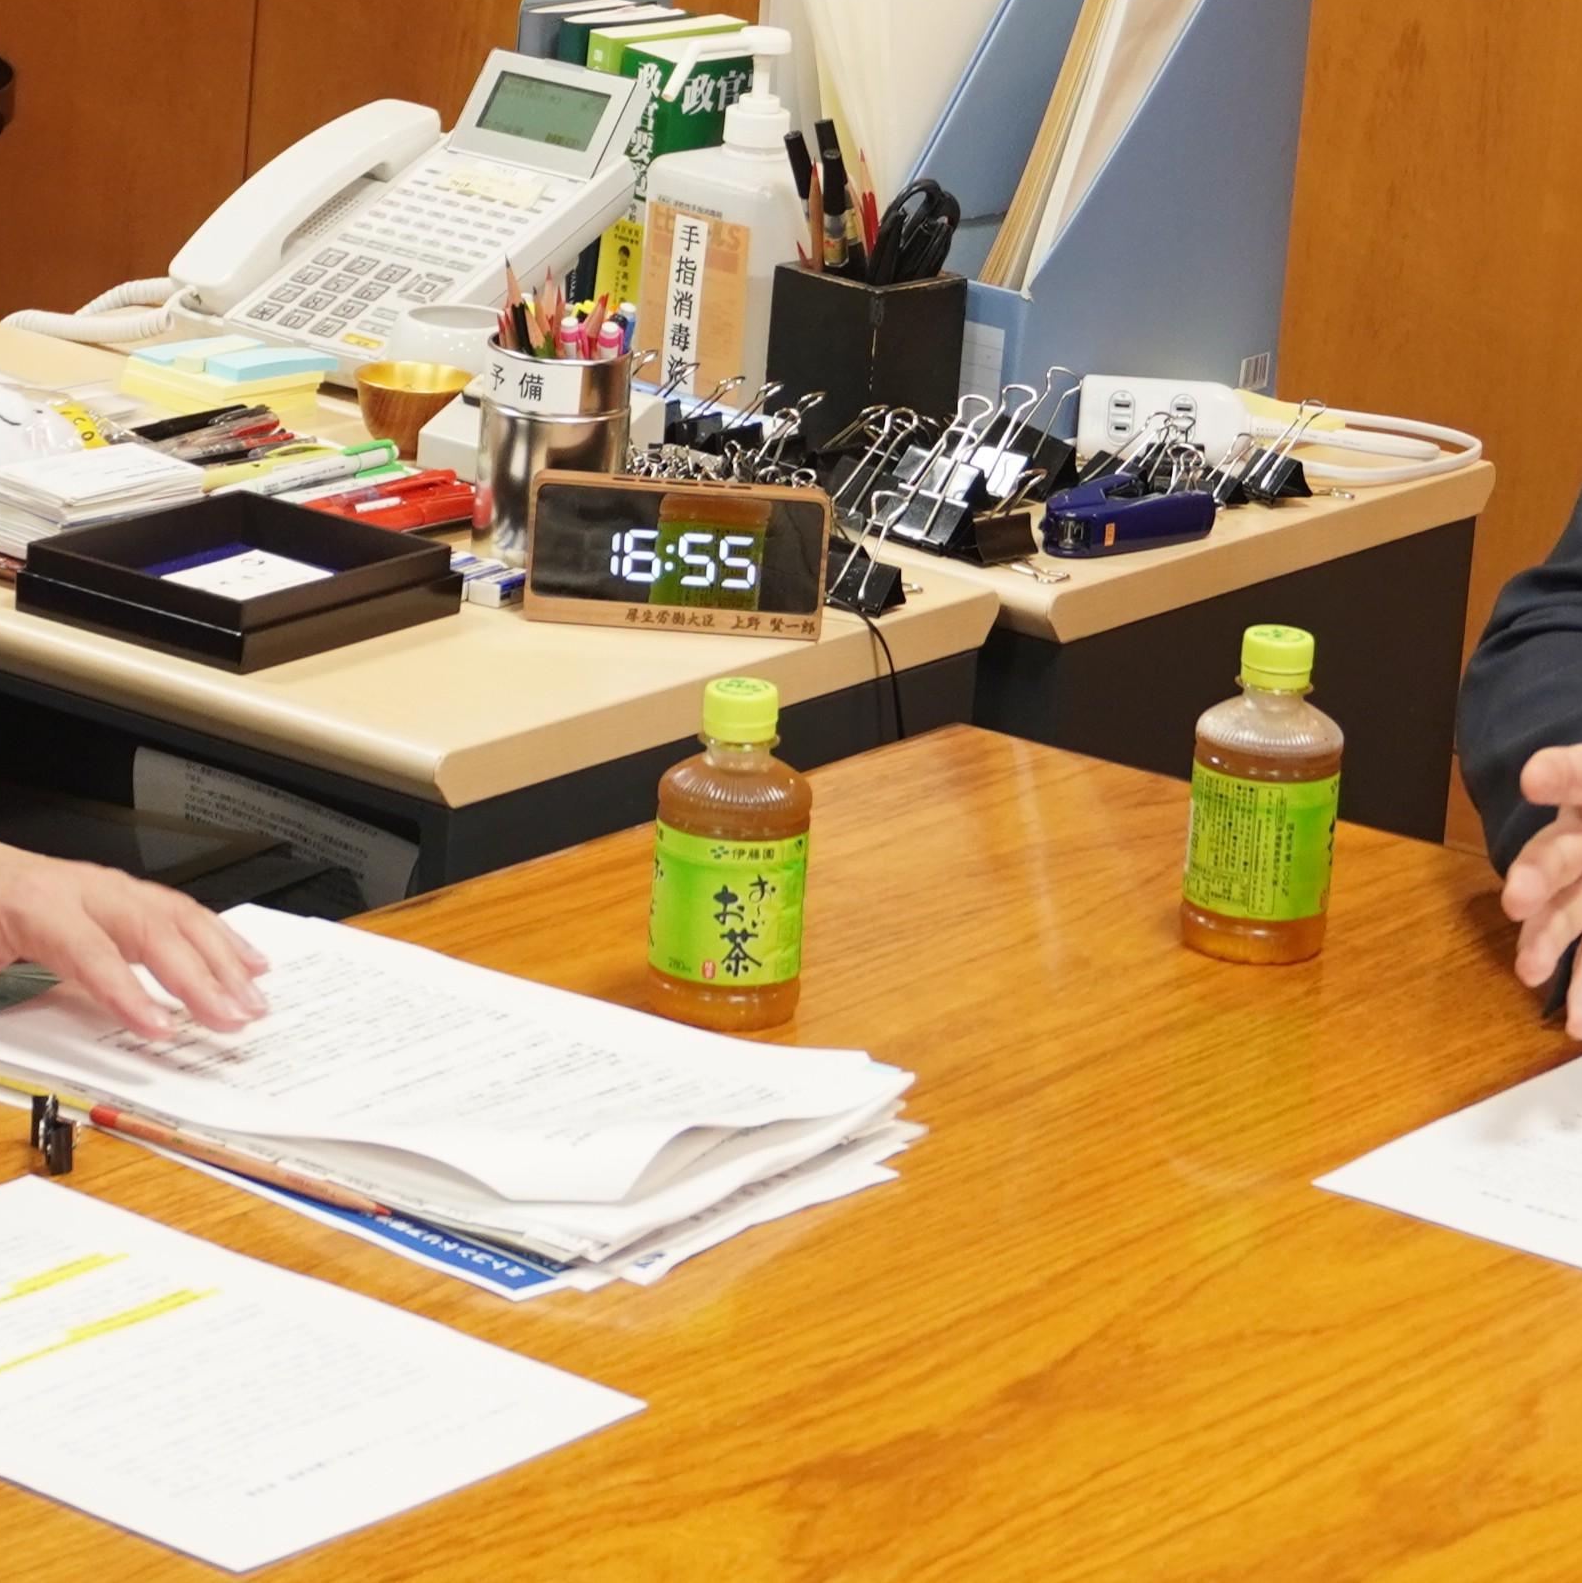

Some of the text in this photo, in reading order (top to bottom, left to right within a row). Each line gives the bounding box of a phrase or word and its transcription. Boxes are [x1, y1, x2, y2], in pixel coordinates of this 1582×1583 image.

[681, 70, 753, 115] 政官
[667, 224, 701, 386] 手指消毒液
[610, 529, 756, 589] 16:55
[625, 608, 816, 635] 厚生労働大臣 上野 賢一郎
[713, 884, 762, 978] お茶
